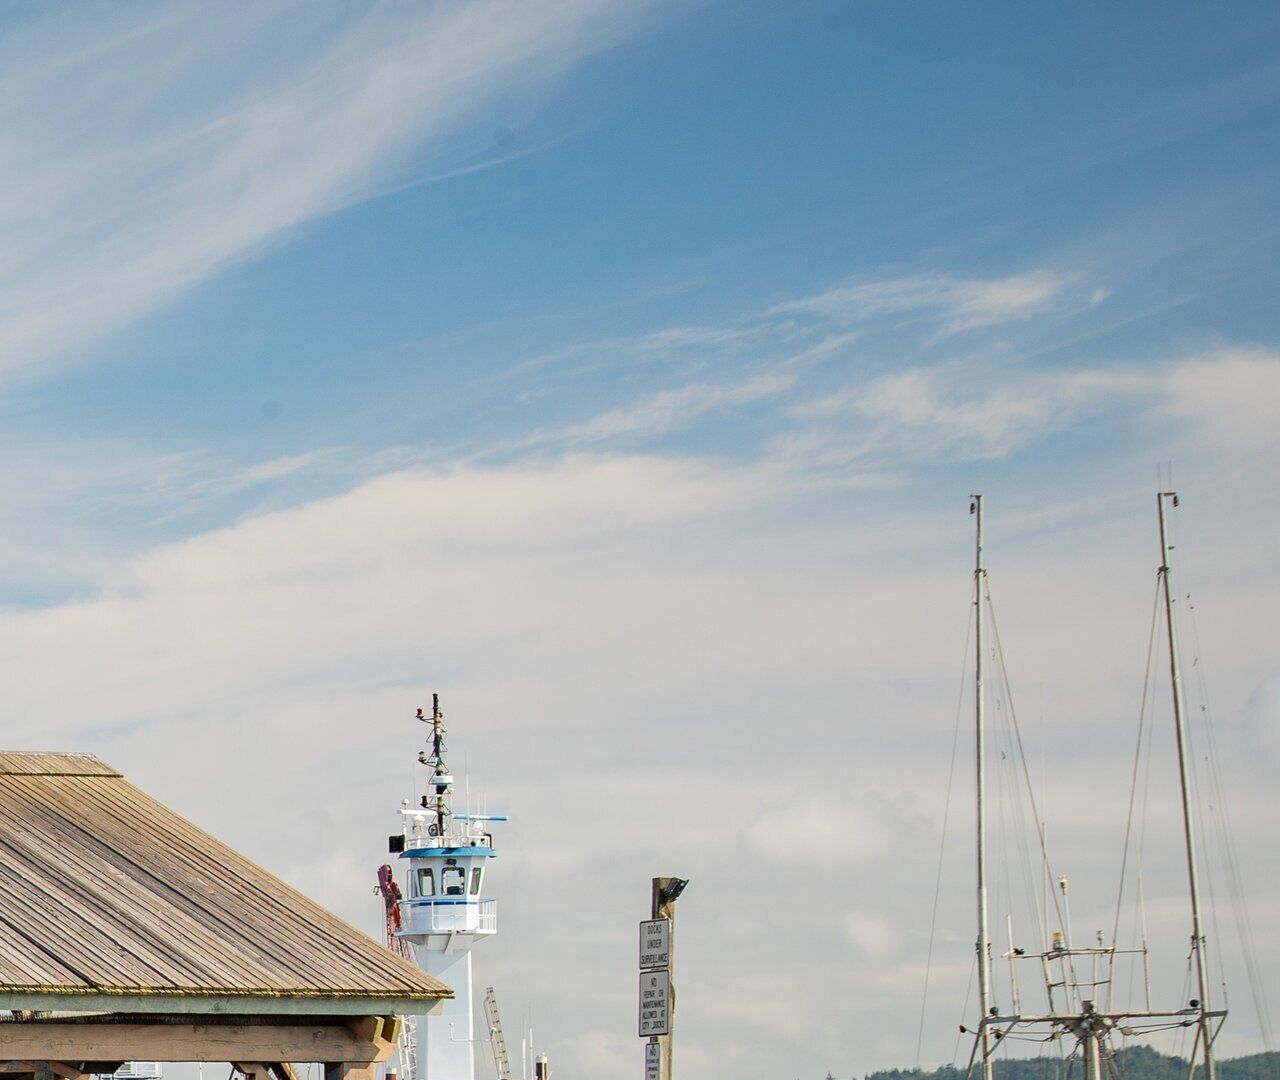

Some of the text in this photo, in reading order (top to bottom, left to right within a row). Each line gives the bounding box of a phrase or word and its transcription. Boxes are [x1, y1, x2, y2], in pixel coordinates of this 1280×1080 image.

[647, 925, 662, 934] DOCKS
[647, 939, 662, 950] UNDER
[641, 953, 668, 964] SURVEILLANCE
[651, 977, 657, 987] NO
